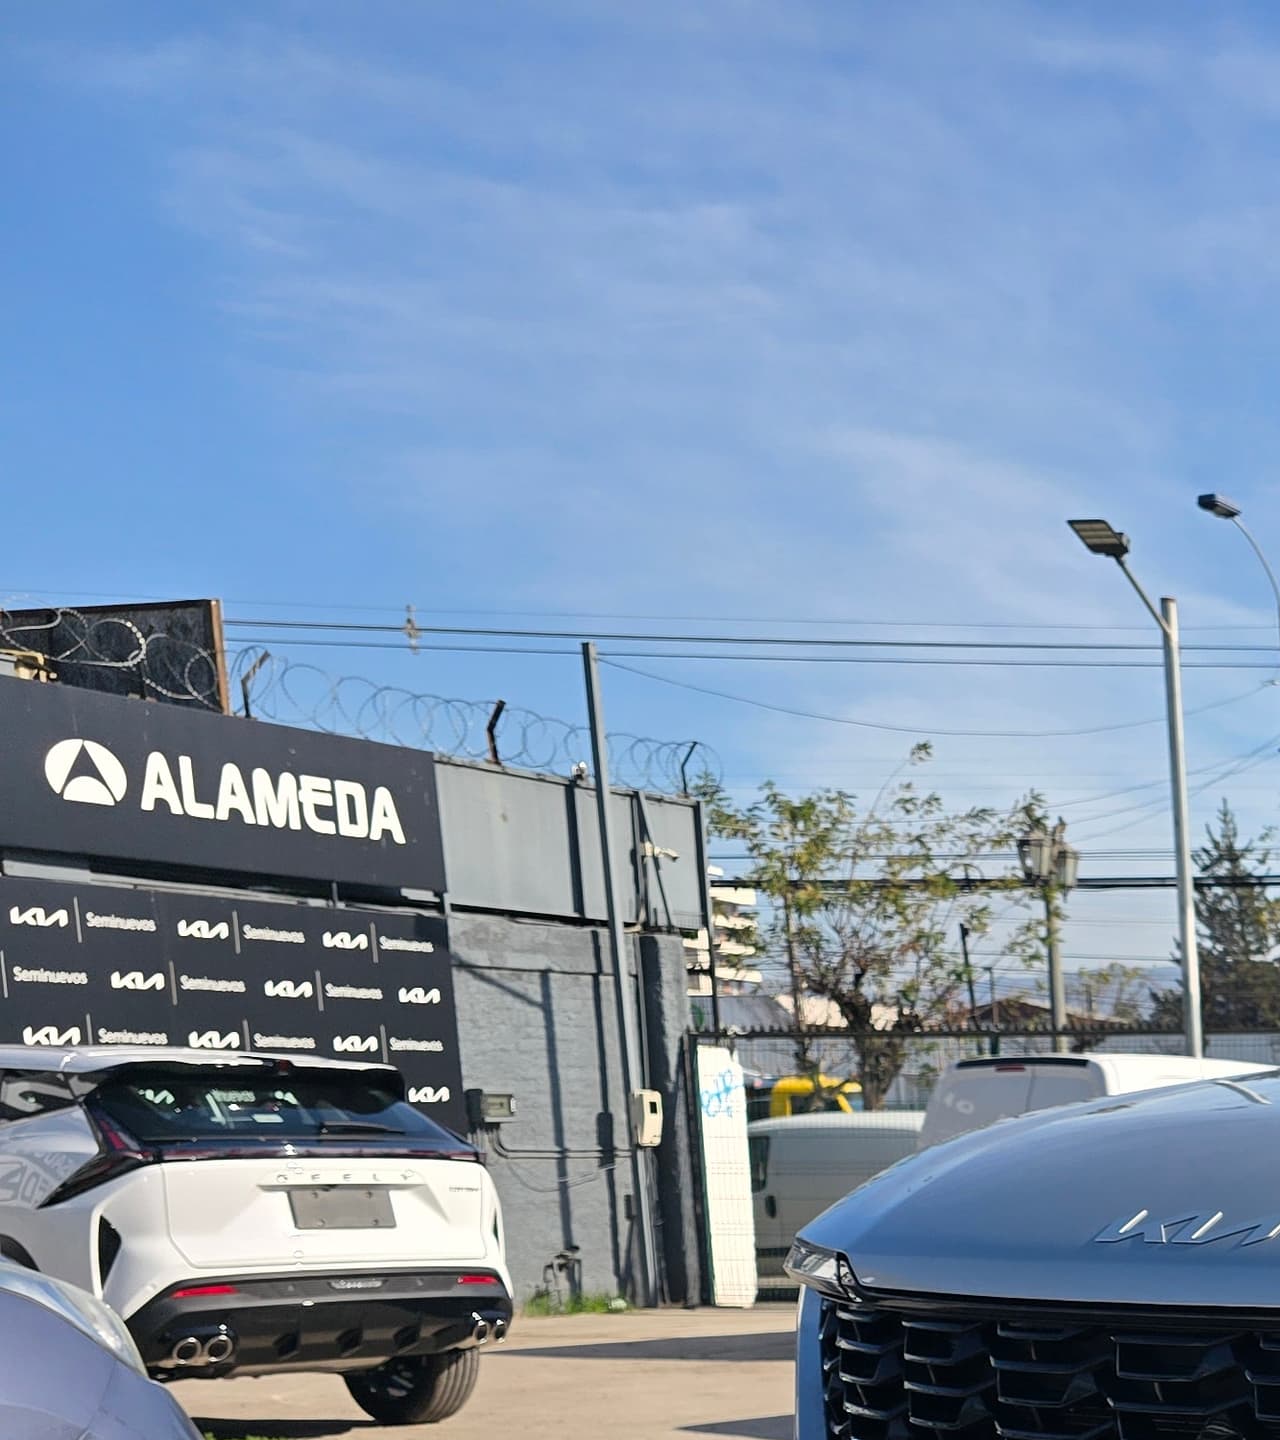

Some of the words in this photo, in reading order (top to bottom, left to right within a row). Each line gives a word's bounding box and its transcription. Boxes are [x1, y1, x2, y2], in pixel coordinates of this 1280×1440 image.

[140, 751, 407, 845] ALAMEDA
[9, 906, 69, 928] KIA
[177, 919, 230, 940] KIA
[322, 931, 369, 951] KIA
[12, 966, 89, 985] Seminuevos
[110, 971, 165, 991] KIA
[264, 980, 313, 998] KIA
[398, 987, 441, 1004] KIA
[22, 1026, 81, 1046] KIA
[188, 1031, 240, 1049] KIA
[332, 1036, 379, 1052] KIA
[407, 1086, 450, 1103] KIA
